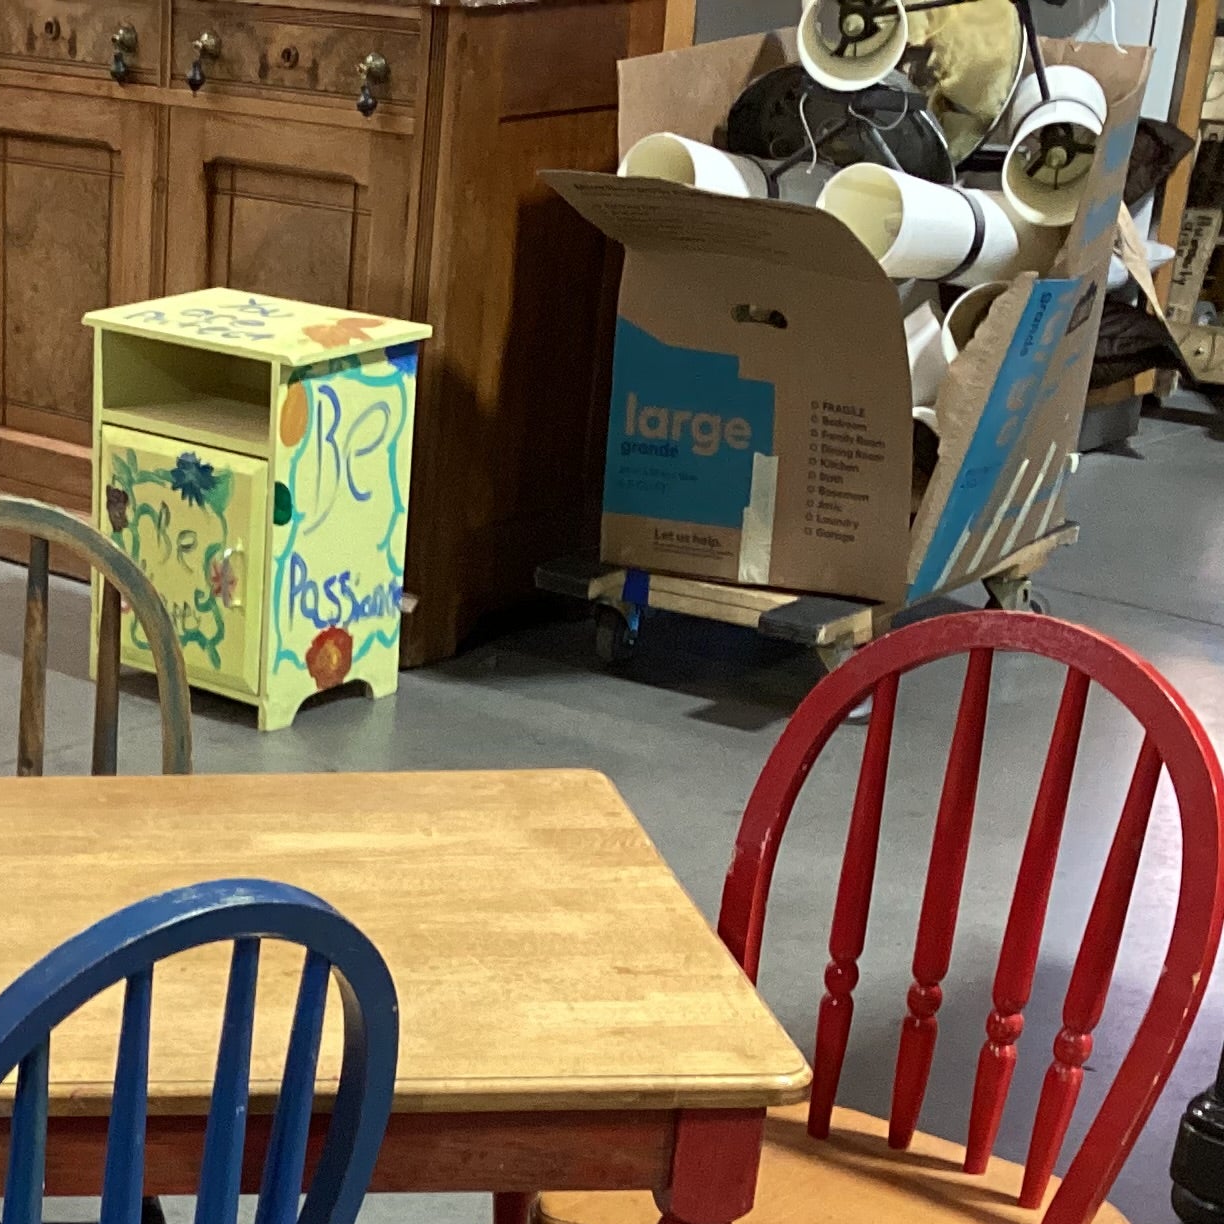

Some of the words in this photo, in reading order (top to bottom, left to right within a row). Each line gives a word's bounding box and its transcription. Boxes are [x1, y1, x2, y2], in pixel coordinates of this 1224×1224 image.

[822, 401, 865, 418] FRAGILE
[626, 391, 752, 456] large
[822, 415, 868, 432] Bedroom
[620, 440, 679, 458] grande
[303, 384, 392, 536] Be
[820, 458, 860, 473] Kitchen
[818, 485, 870, 501] Basement
[816, 514, 860, 530] Laundry
[156, 500, 199, 574] Be
[816, 528, 856, 543] Garage
